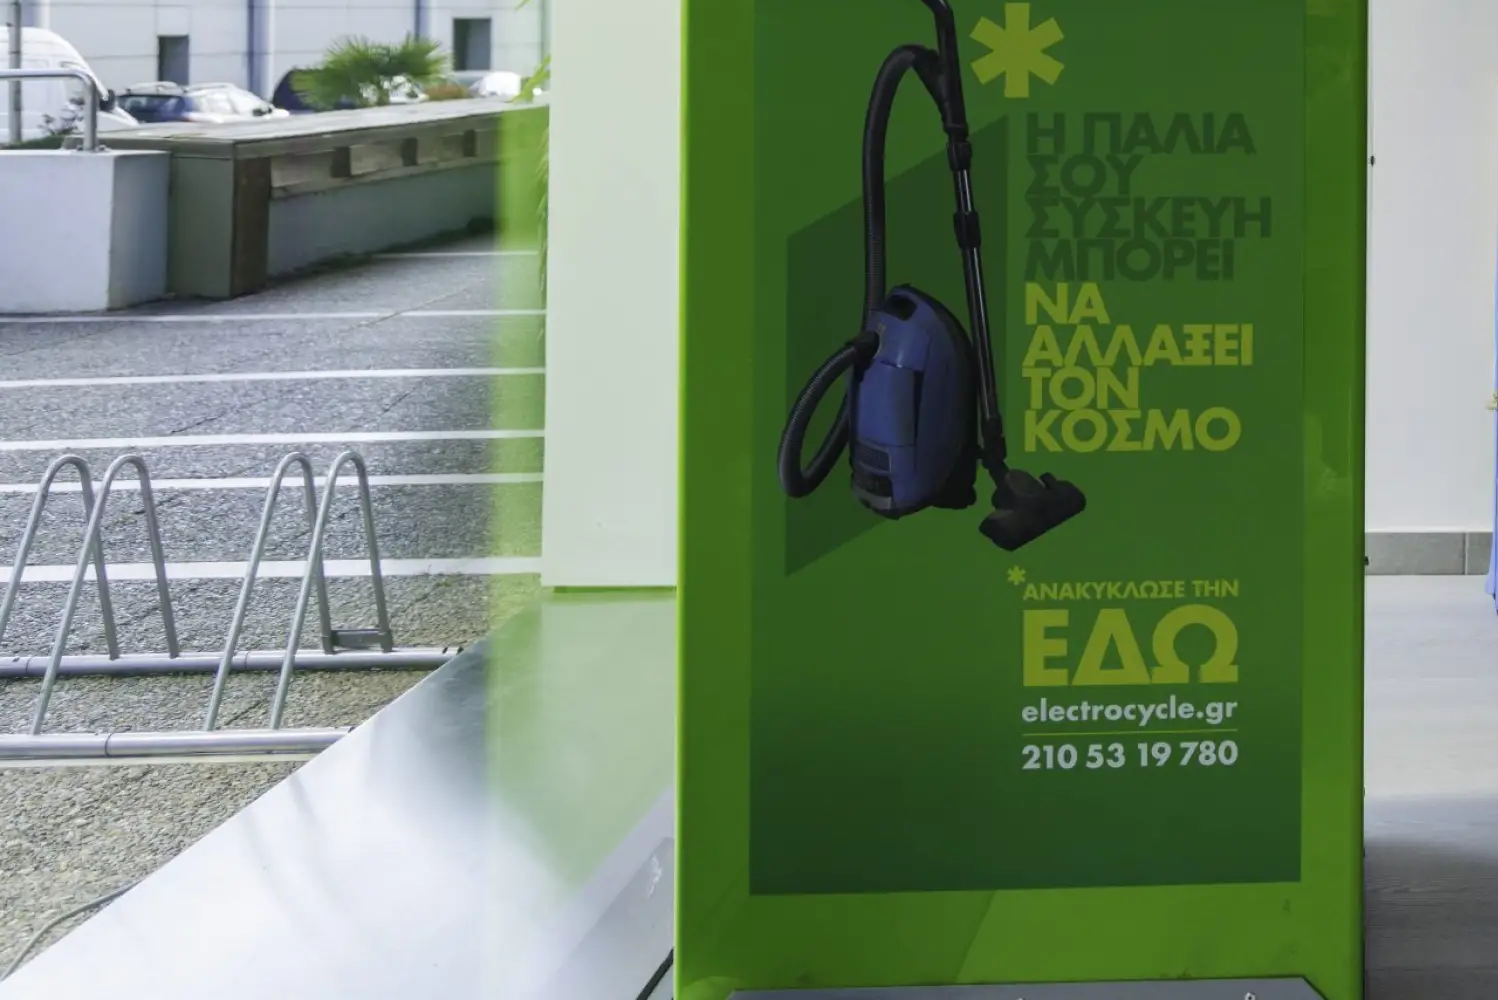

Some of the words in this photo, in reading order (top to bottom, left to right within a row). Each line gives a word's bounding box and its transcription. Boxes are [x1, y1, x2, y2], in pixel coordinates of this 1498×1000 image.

[1026, 112, 1066, 154] Η
[1083, 111, 1257, 155] ΠΑΛΙΑ
[1025, 154, 1143, 198] ΣΟΥ
[1025, 196, 1272, 239] ΣΥΣΚΕΥΗ
[1023, 238, 1235, 282] ΜΠΟΡΕΙ
[1025, 282, 1111, 325] ΝΑ
[1022, 323, 1254, 367] ΑΛΛΑΞΕΙ
[1021, 365, 1140, 411] ΤΟΝ
[1025, 407, 1242, 452] ΚΟΣΜΟ
[1191, 579, 1239, 598] ΤΗΝ
[1023, 604, 1239, 687] ΕΔΩ
[1021, 694, 1239, 726] electrocycle.gr
[1021, 744, 1078, 770] 210
[1085, 742, 1126, 769] 53
[1137, 741, 1172, 767] 19
[1179, 740, 1239, 766] 780
